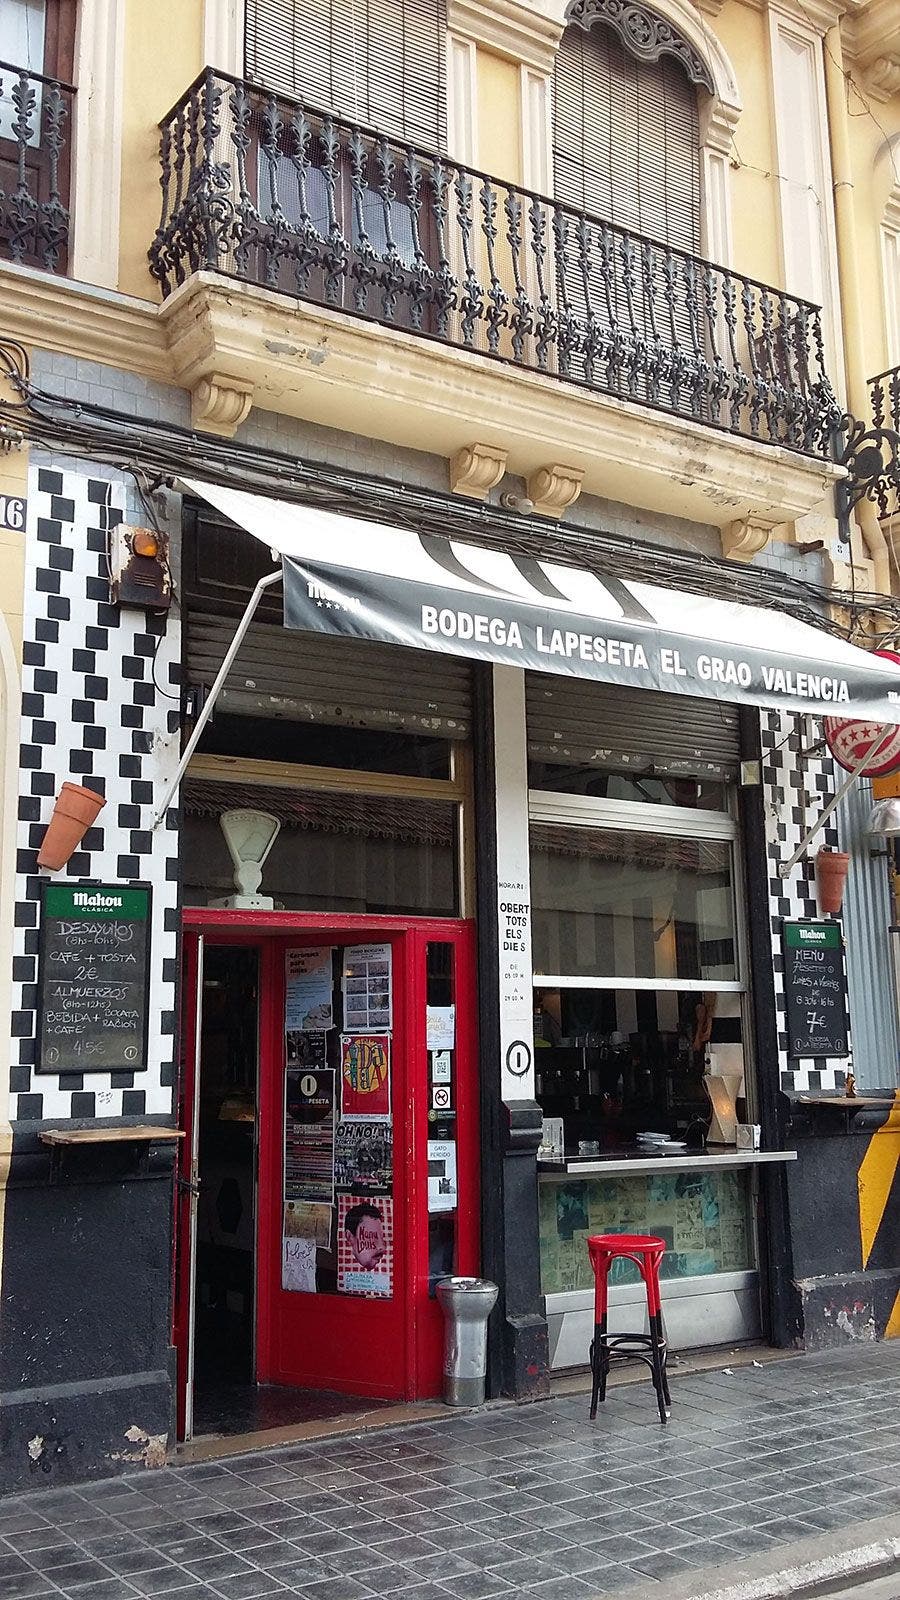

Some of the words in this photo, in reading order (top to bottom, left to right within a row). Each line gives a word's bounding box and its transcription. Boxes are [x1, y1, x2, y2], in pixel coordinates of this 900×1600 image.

[421, 604, 524, 650] BODEGA
[536, 626, 649, 670] LAPESETA
[660, 649, 687, 676] EL
[696, 654, 752, 687] GRAO
[761, 665, 850, 704] VALENCIA
[73, 892, 123, 907] Mahou
[500, 902, 529, 914] OBERT
[505, 915, 527, 927] TOTS
[505, 928, 522, 940] ELS
[799, 929, 827, 940] Mahou
[97, 952, 137, 964] TOSTA
[46, 1011, 91, 1023] BEBIDA
[806, 1011, 827, 1034] 7€
[336, 1124, 355, 1139] OH
[355, 1124, 378, 1140] NO!
